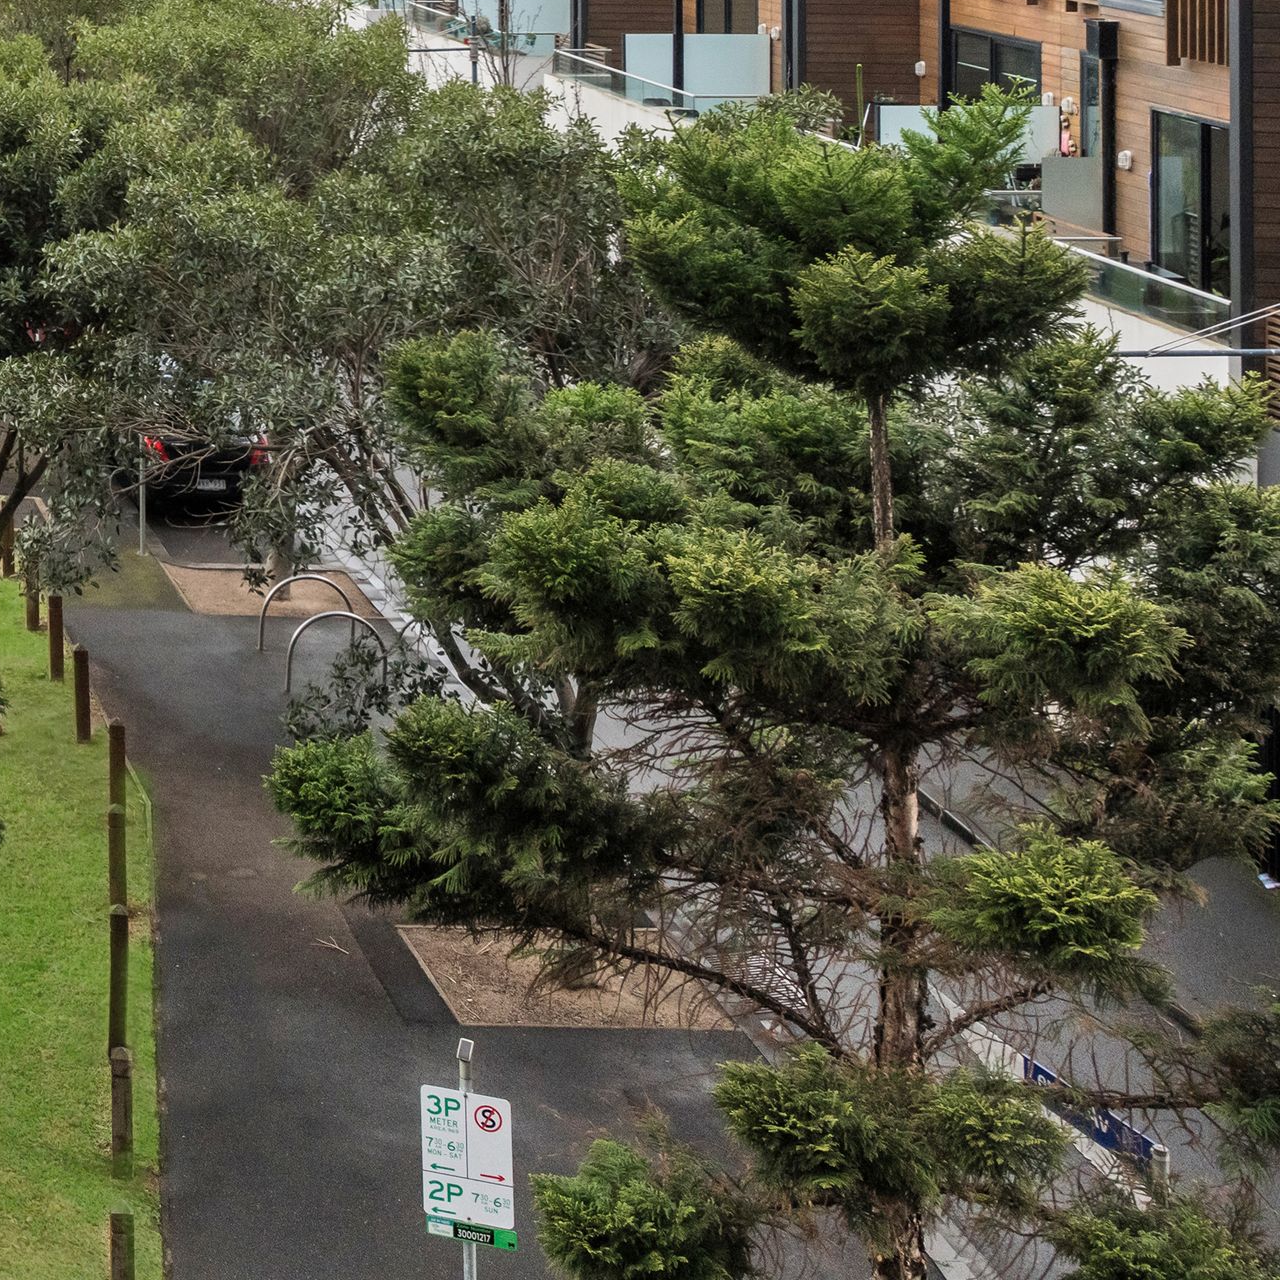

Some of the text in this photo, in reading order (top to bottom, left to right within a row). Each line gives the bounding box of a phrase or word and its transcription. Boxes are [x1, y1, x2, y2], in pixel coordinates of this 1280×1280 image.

[427, 1094, 461, 1117] 3P
[429, 1117, 458, 1128] METER
[427, 1148, 442, 1156] MON
[449, 1152, 462, 1160] SAT
[428, 1180, 463, 1203] 2P
[457, 1228, 491, 1243] 30001217
